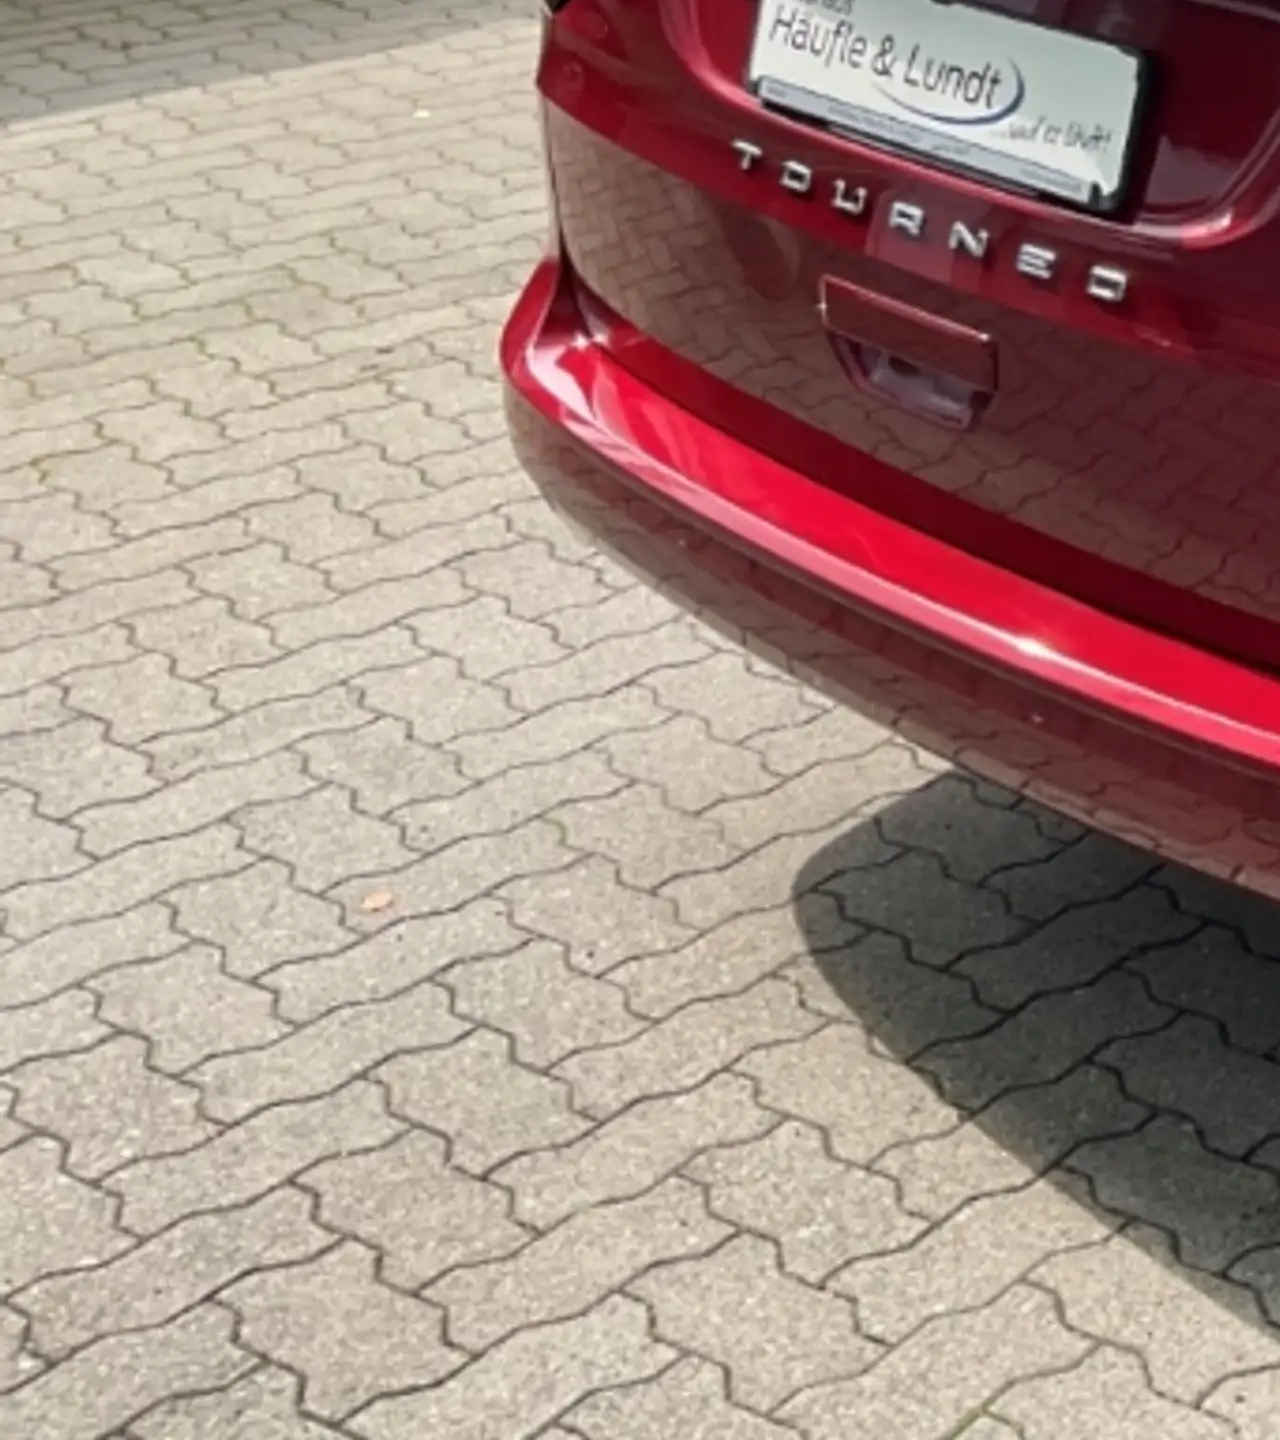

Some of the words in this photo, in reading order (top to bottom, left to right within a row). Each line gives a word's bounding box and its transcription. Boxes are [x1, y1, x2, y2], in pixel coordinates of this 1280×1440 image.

[871, 32, 898, 78] &
[904, 43, 1002, 109] Lundt
[732, 139, 1129, 303] TOURNEO
